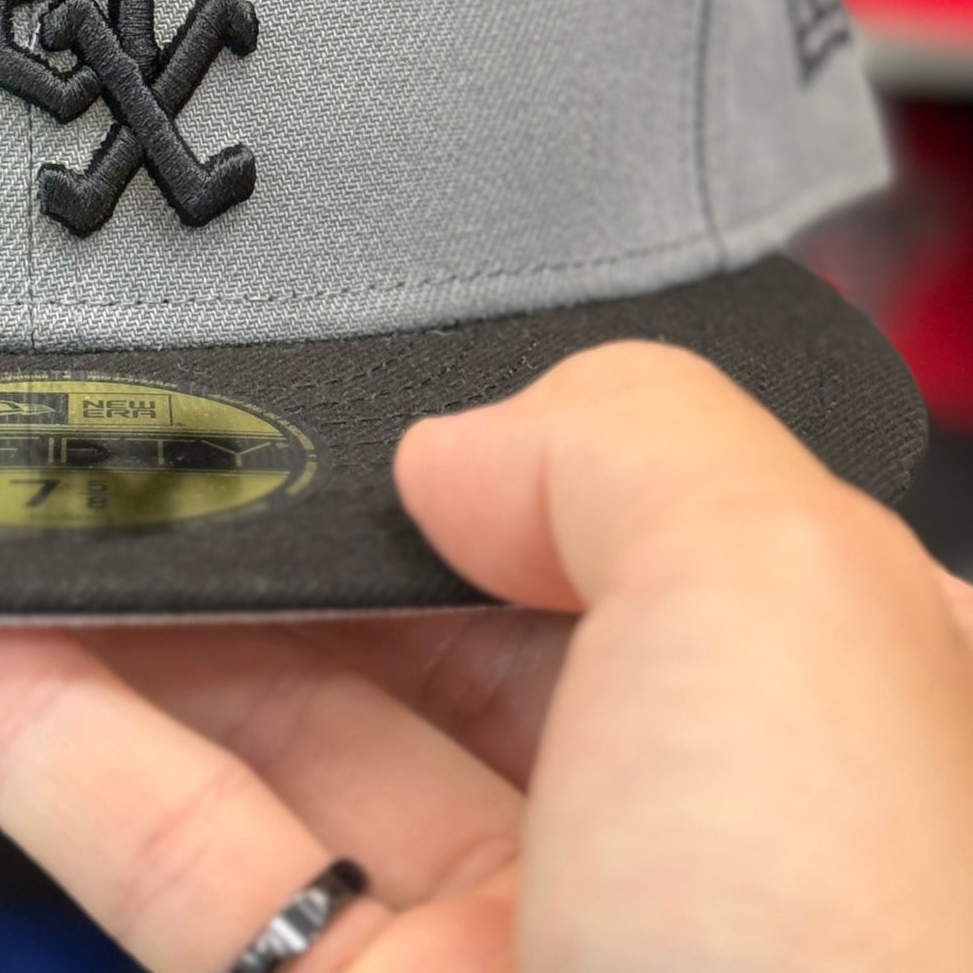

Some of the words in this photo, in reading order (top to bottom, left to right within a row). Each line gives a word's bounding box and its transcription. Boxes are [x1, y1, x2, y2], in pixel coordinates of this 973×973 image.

[82, 399, 156, 409] NEW
[82, 409, 157, 419] ERA
[9, 479, 61, 508] 7
